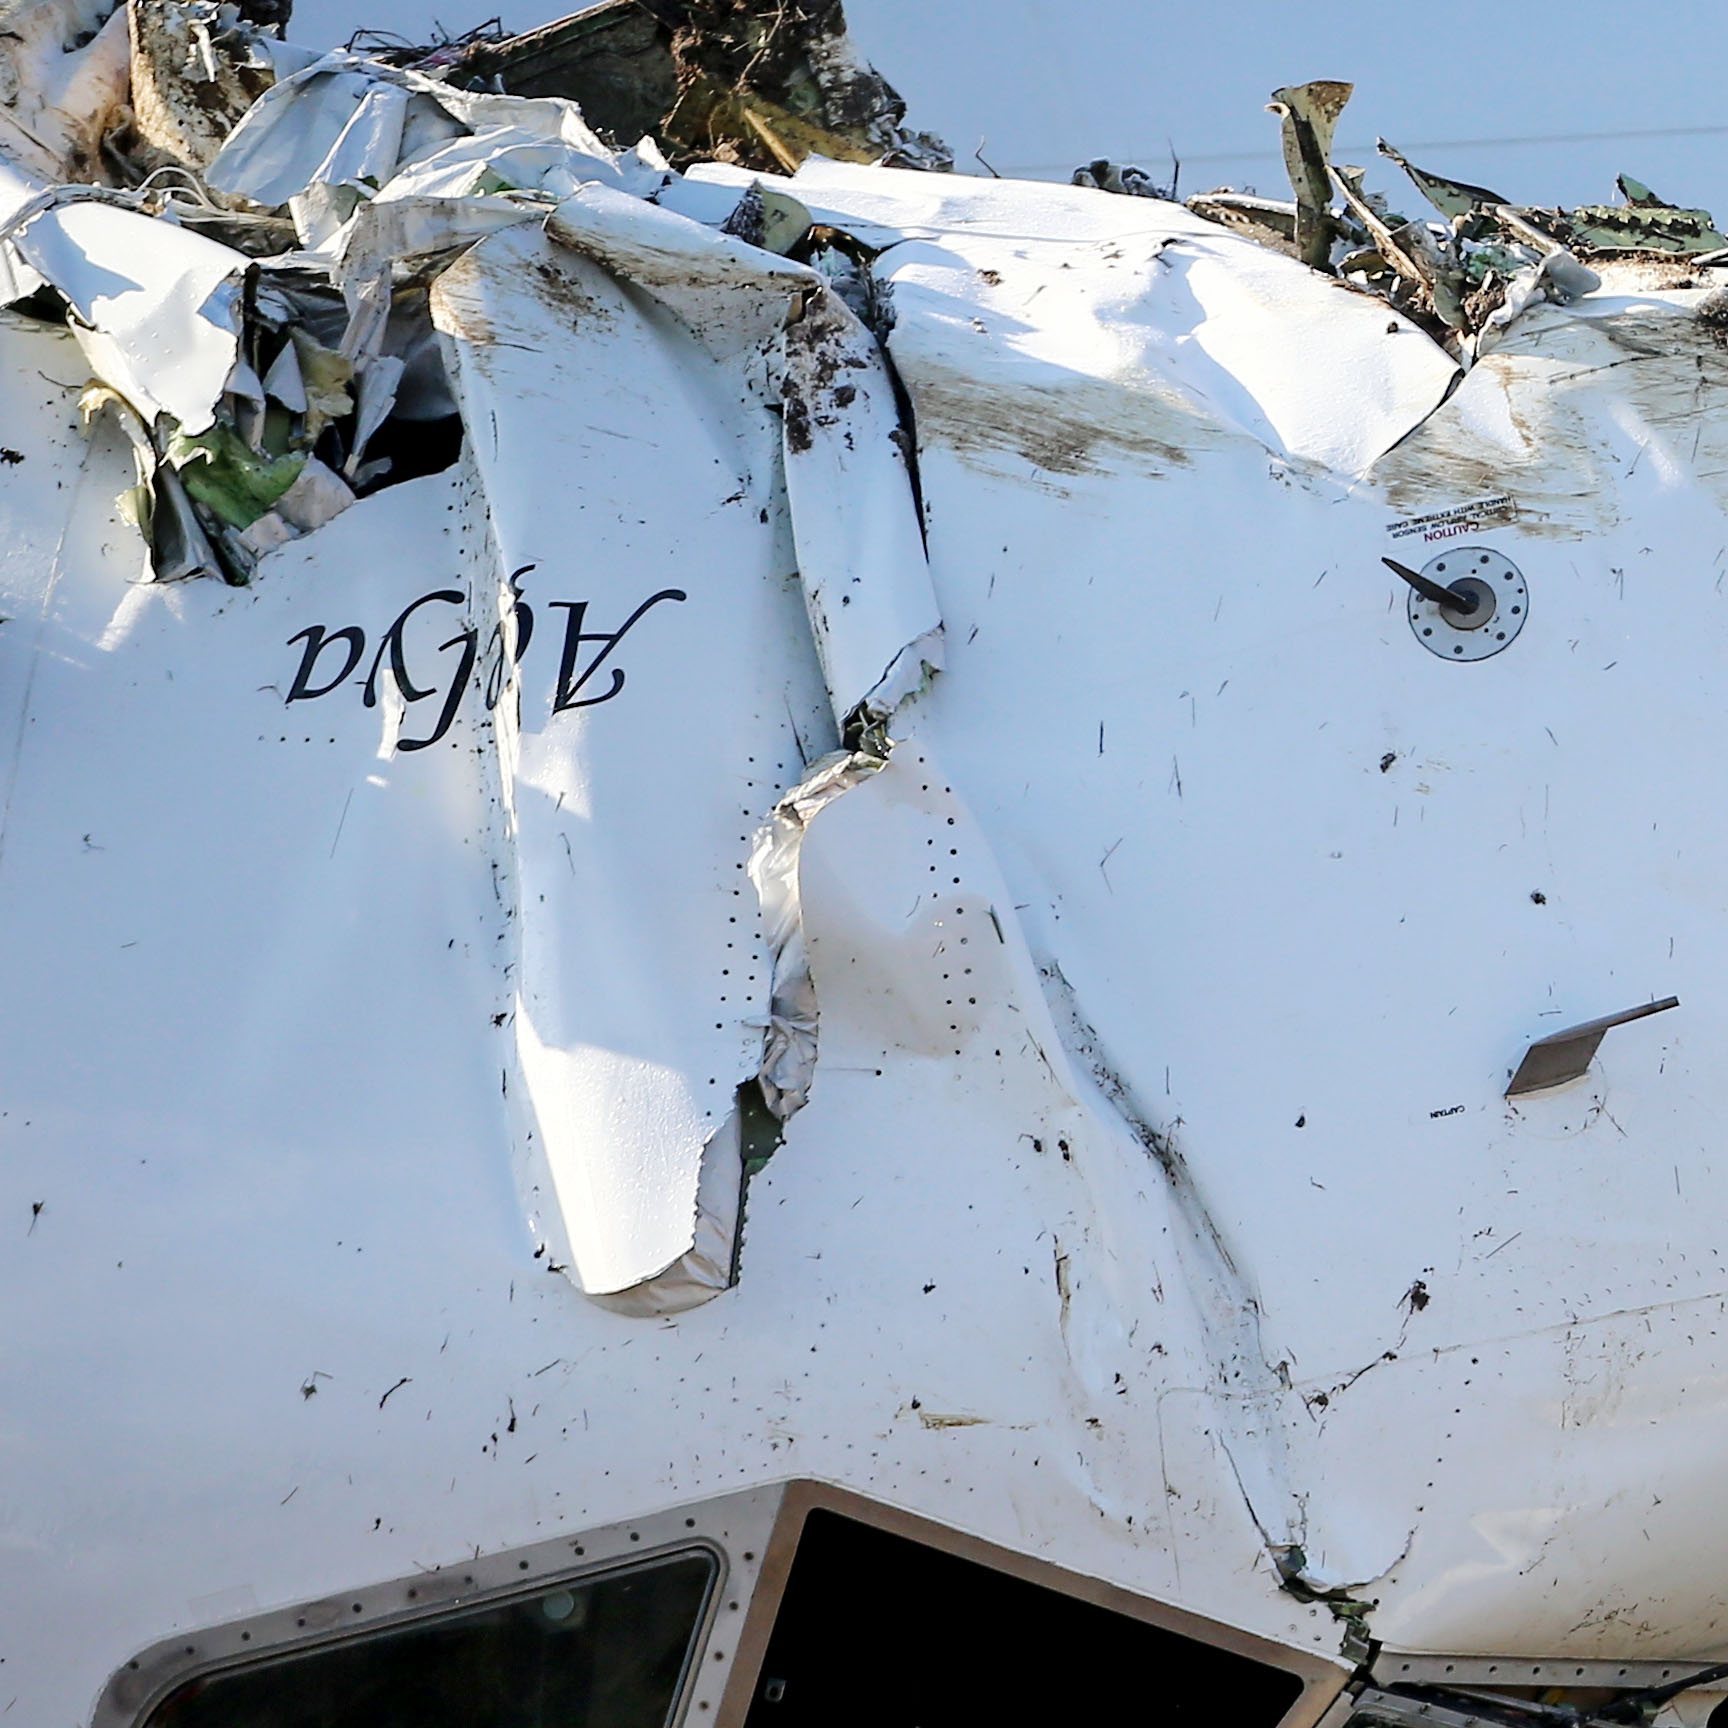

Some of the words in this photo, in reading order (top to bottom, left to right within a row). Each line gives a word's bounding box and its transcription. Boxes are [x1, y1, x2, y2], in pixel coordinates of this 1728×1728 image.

[1477, 496, 1511, 510] HANDLE
[1452, 505, 1475, 516] WITH
[1412, 511, 1451, 526] EXTREME
[1430, 515, 1467, 530] AIRFLOW
[1385, 521, 1408, 532] CARE
[1392, 525, 1427, 539] SENSOR
[1423, 521, 1480, 542] CAUTION
[1429, 1104, 1465, 1119] CAPTAIN
